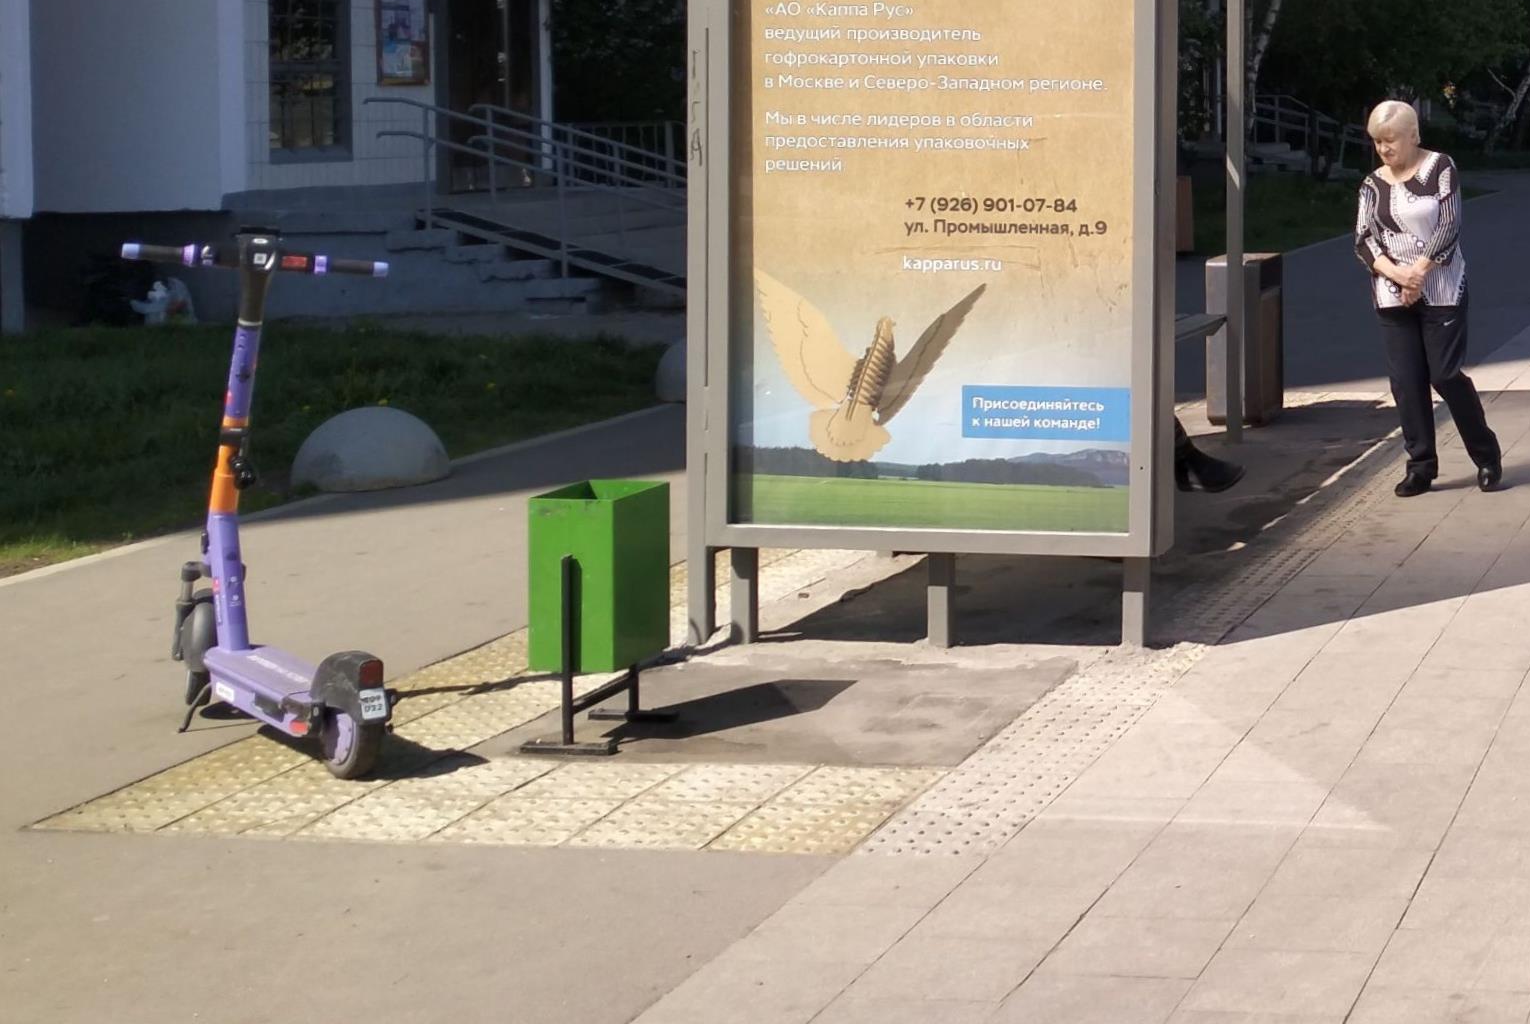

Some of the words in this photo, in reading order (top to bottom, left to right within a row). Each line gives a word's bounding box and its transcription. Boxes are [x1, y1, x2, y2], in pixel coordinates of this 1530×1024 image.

[765, 2, 800, 16] «АО
[806, 2, 868, 16] «Каппа
[873, 2, 913, 19] Рус»
[765, 26, 841, 41] ведущий
[847, 28, 982, 42] производитель
[765, 50, 912, 67] гофрокартонной
[917, 54, 998, 68] упаковки
[764, 77, 774, 89] в
[778, 74, 844, 89] Москве
[849, 78, 859, 89] и
[864, 75, 1024, 91] Северо-Западном
[1029, 79, 1107, 93] регионе.
[765, 111, 792, 125] Мы
[797, 114, 806, 125] в
[811, 114, 862, 126] числе
[867, 115, 941, 128] лидеров
[946, 115, 955, 126] в
[960, 112, 1033, 127] области
[764, 136, 909, 150] предоставления
[914, 138, 1029, 151] упаковочных
[904, 197, 926, 211] +7
[930, 197, 978, 214] (926)
[983, 198, 1078, 213] 901-07-84
[904, 221, 929, 236] ул.
[933, 219, 1074, 237] Промышленная,
[1078, 221, 1108, 236] д.9
[903, 256, 1002, 272] kapparus.ru
[972, 397, 1105, 411] Присоединяйтесь
[972, 417, 980, 427] к
[984, 415, 1030, 428] нашей
[1034, 417, 1100, 430] команде!
